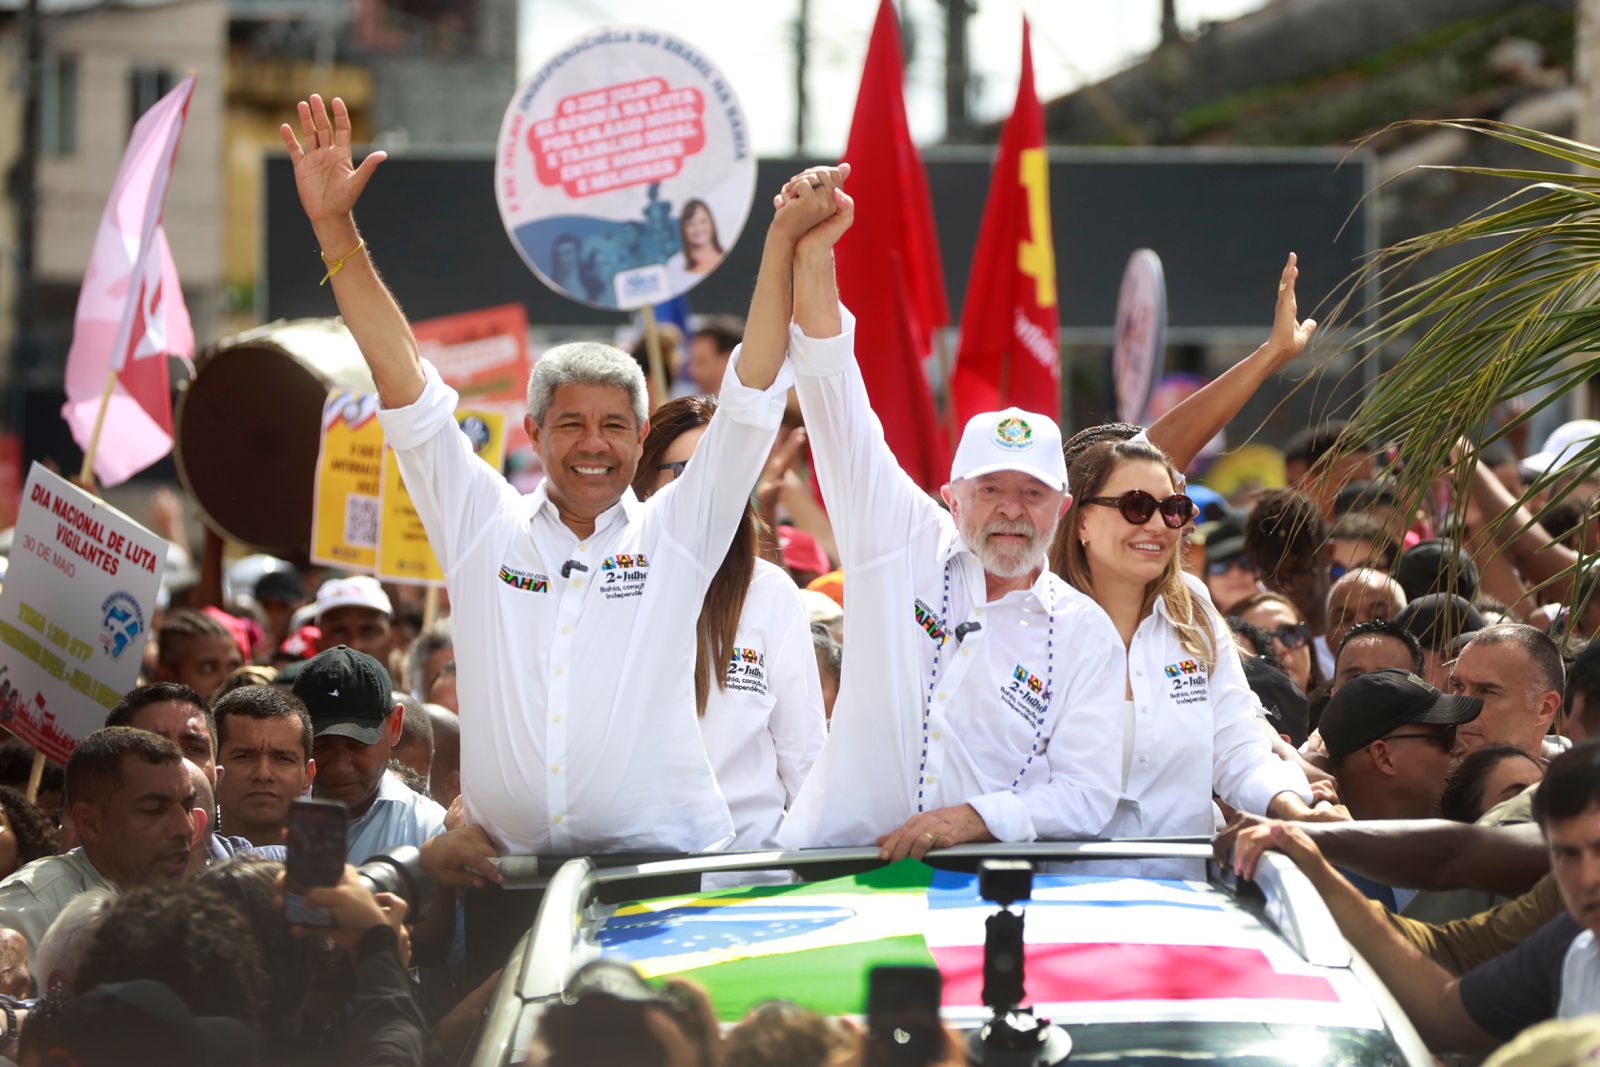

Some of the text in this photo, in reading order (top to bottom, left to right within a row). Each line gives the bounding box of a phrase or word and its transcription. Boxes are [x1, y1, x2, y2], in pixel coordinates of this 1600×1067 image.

[726, 106, 746, 160] BAHIA
[31, 483, 157, 574] DIA NACIONAL DE LUTA
[22, 534, 76, 578] 30 DE MAIO
[56, 523, 120, 576] VIGILANTES
[498, 567, 551, 593] BAHIA
[501, 564, 526, 577] GOVERNO
[606, 571, 616, 583] 2
[600, 585, 622, 593] Bahia,
[728, 663, 737, 674] 2
[1008, 681, 1020, 692] 2
[1022, 690, 1045, 713] Julho
[1173, 679, 1182, 690] 2
